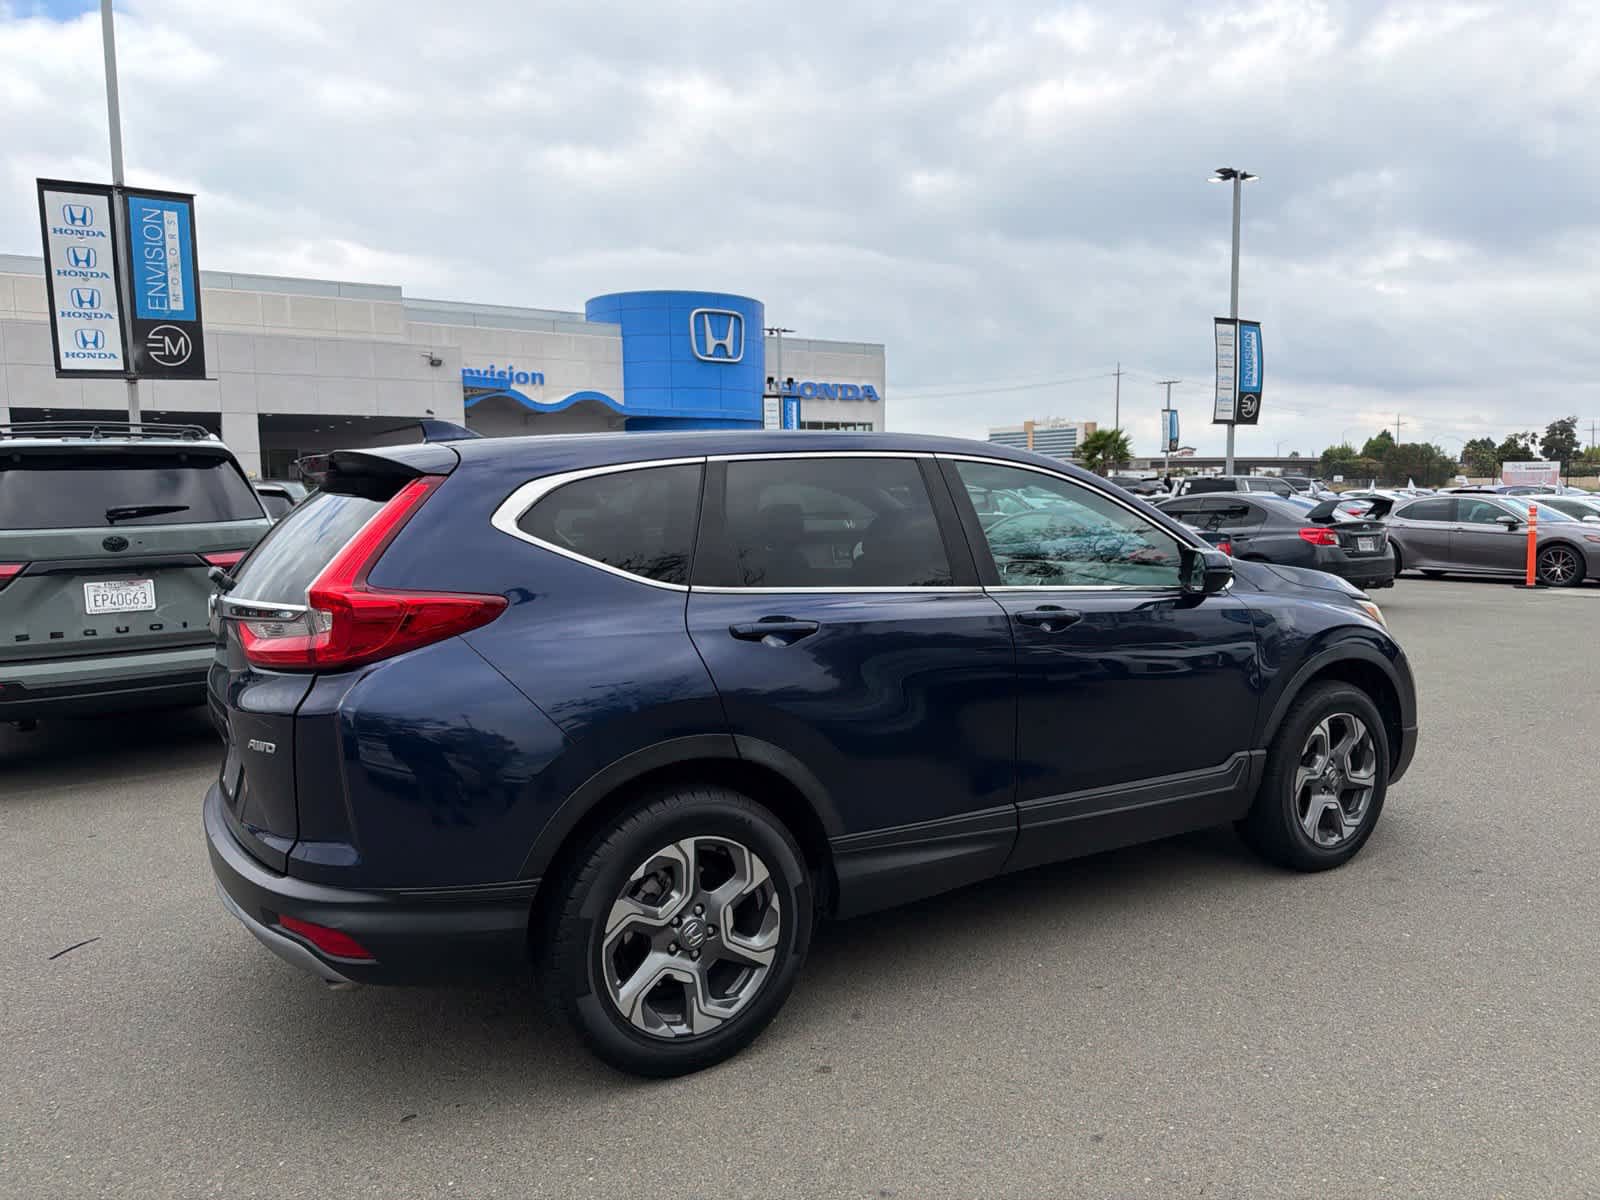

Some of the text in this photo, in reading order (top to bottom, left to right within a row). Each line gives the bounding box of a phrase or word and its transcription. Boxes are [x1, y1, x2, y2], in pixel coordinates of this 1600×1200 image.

[52, 227, 107, 238] HONDA
[142, 207, 168, 311] ENVISION
[166, 218, 181, 303] MOTORS
[56, 269, 112, 279] HONDA
[60, 311, 114, 320] HONDA
[64, 351, 118, 360] HONDA
[462, 363, 545, 386] nvision
[781, 381, 881, 402] HONDA
[15, 621, 211, 642] SEQUOI
[248, 739, 276, 754] AWD
